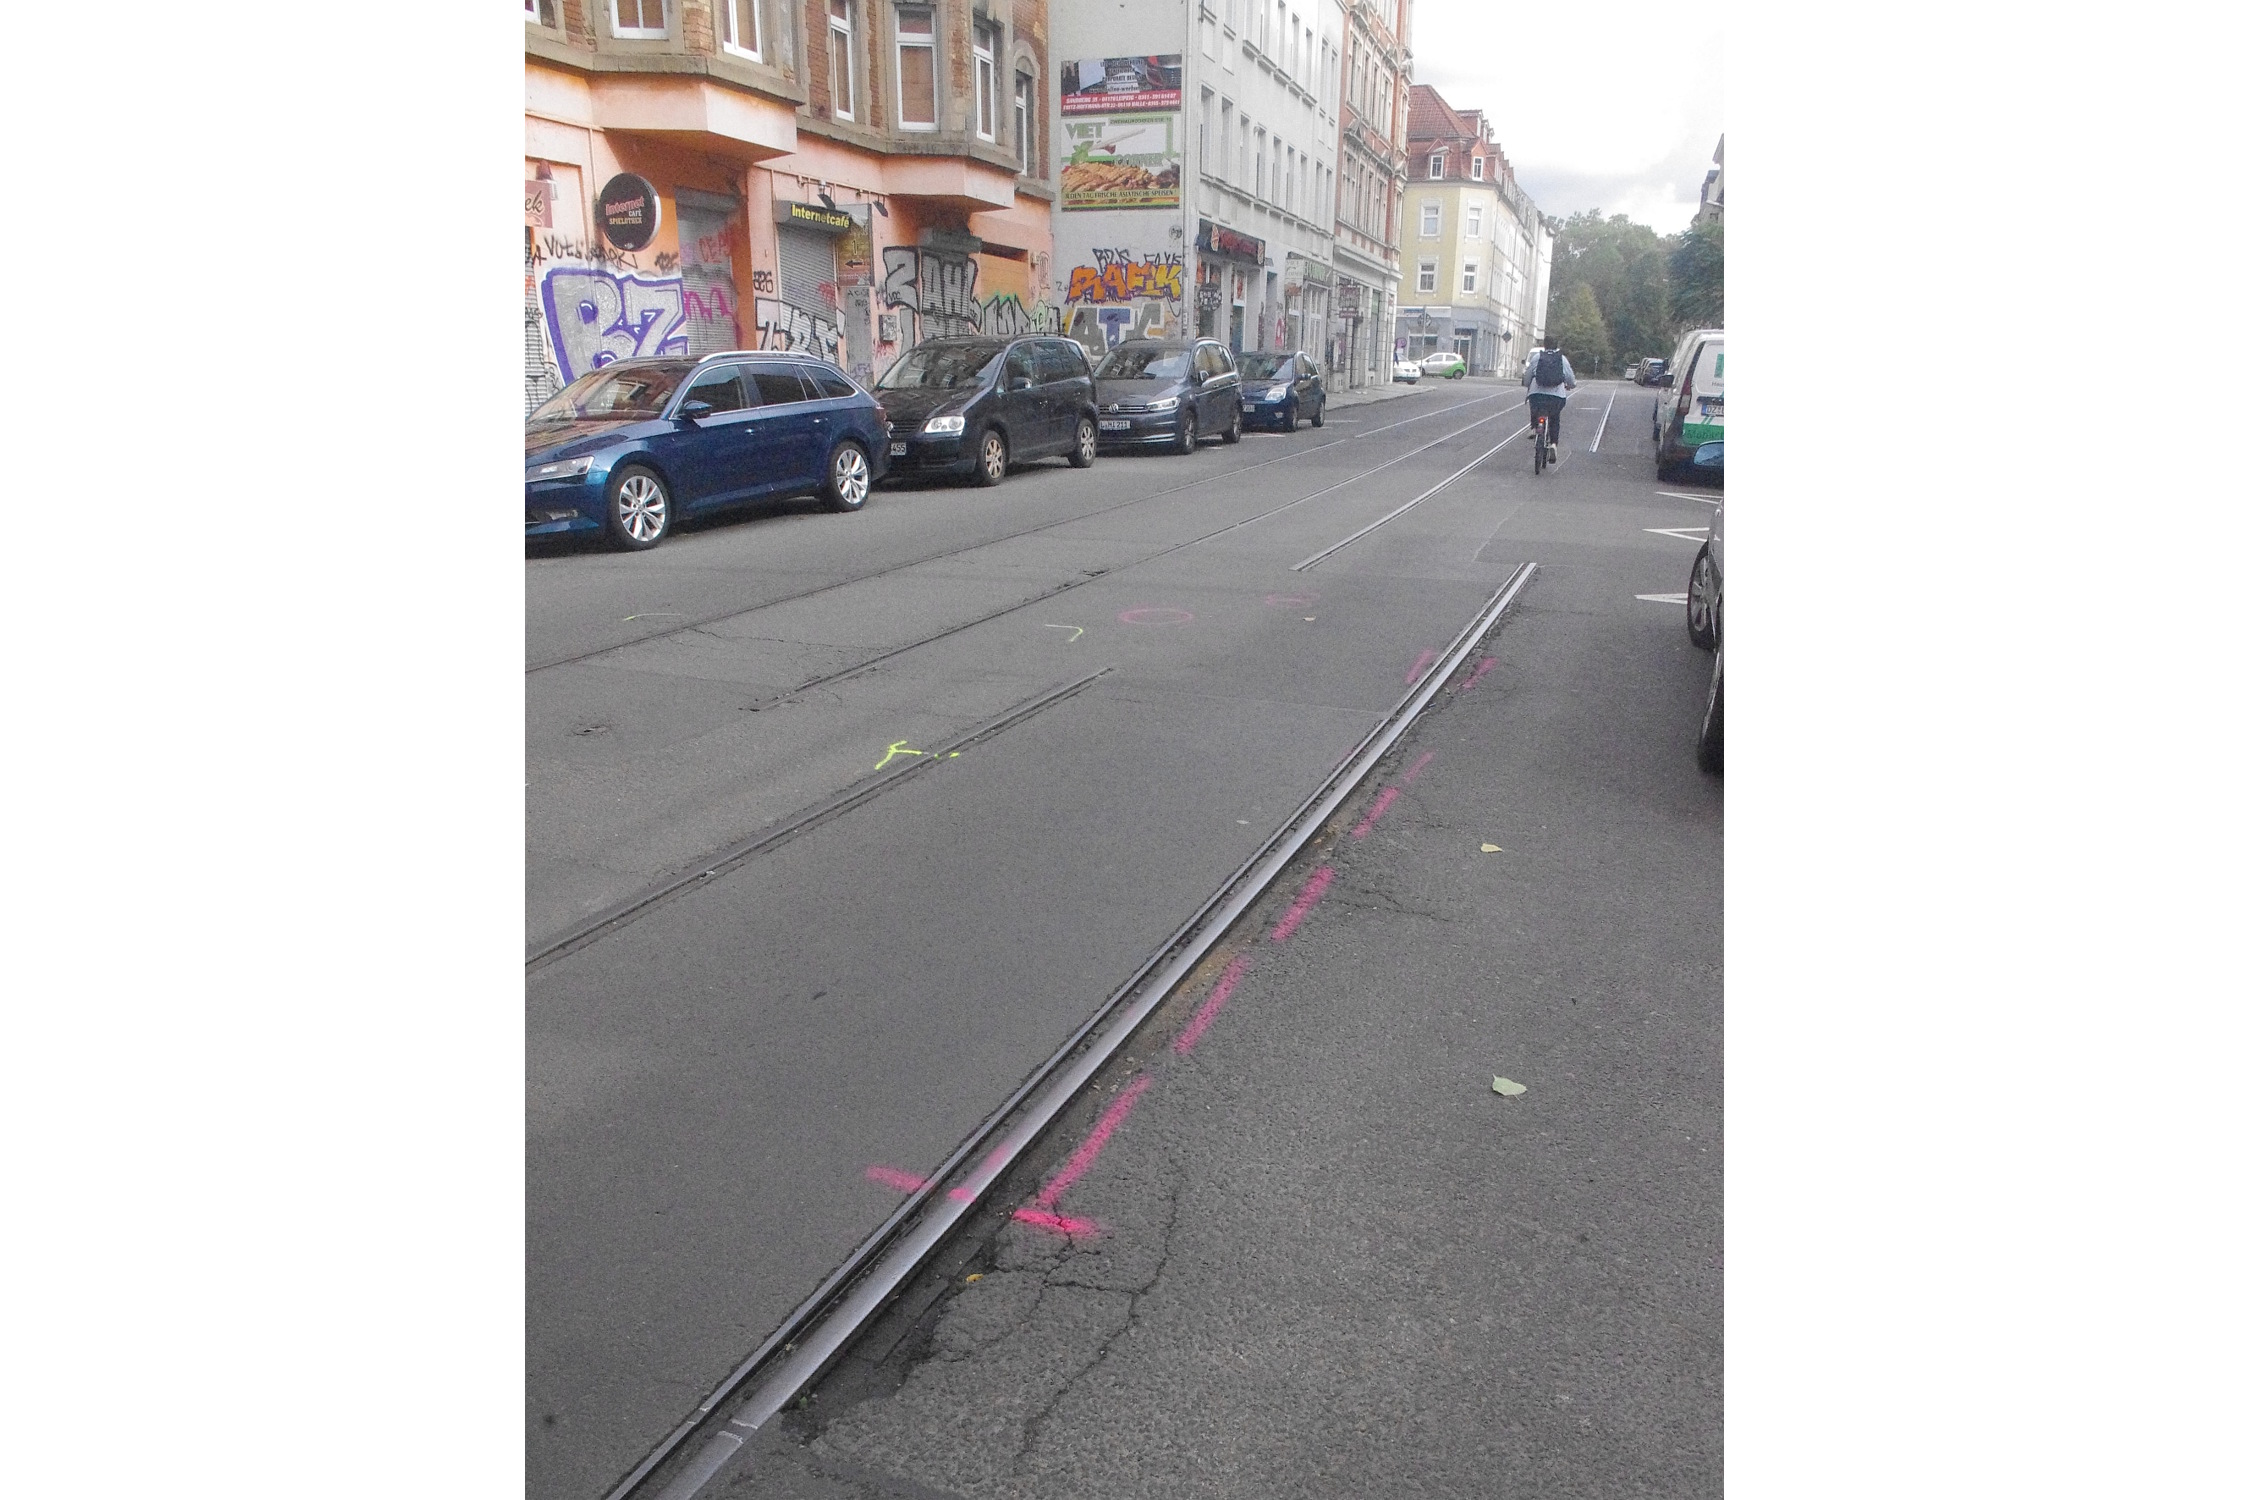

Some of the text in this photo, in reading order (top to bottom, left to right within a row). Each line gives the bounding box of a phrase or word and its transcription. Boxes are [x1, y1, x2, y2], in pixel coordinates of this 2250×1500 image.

[1065, 121, 1106, 140] VIET
[1119, 190, 1149, 198] ASIATISCHE
[605, 196, 645, 216] Internet
[609, 217, 642, 225] SPIELOTHEK
[791, 204, 850, 229] Internetcafé
